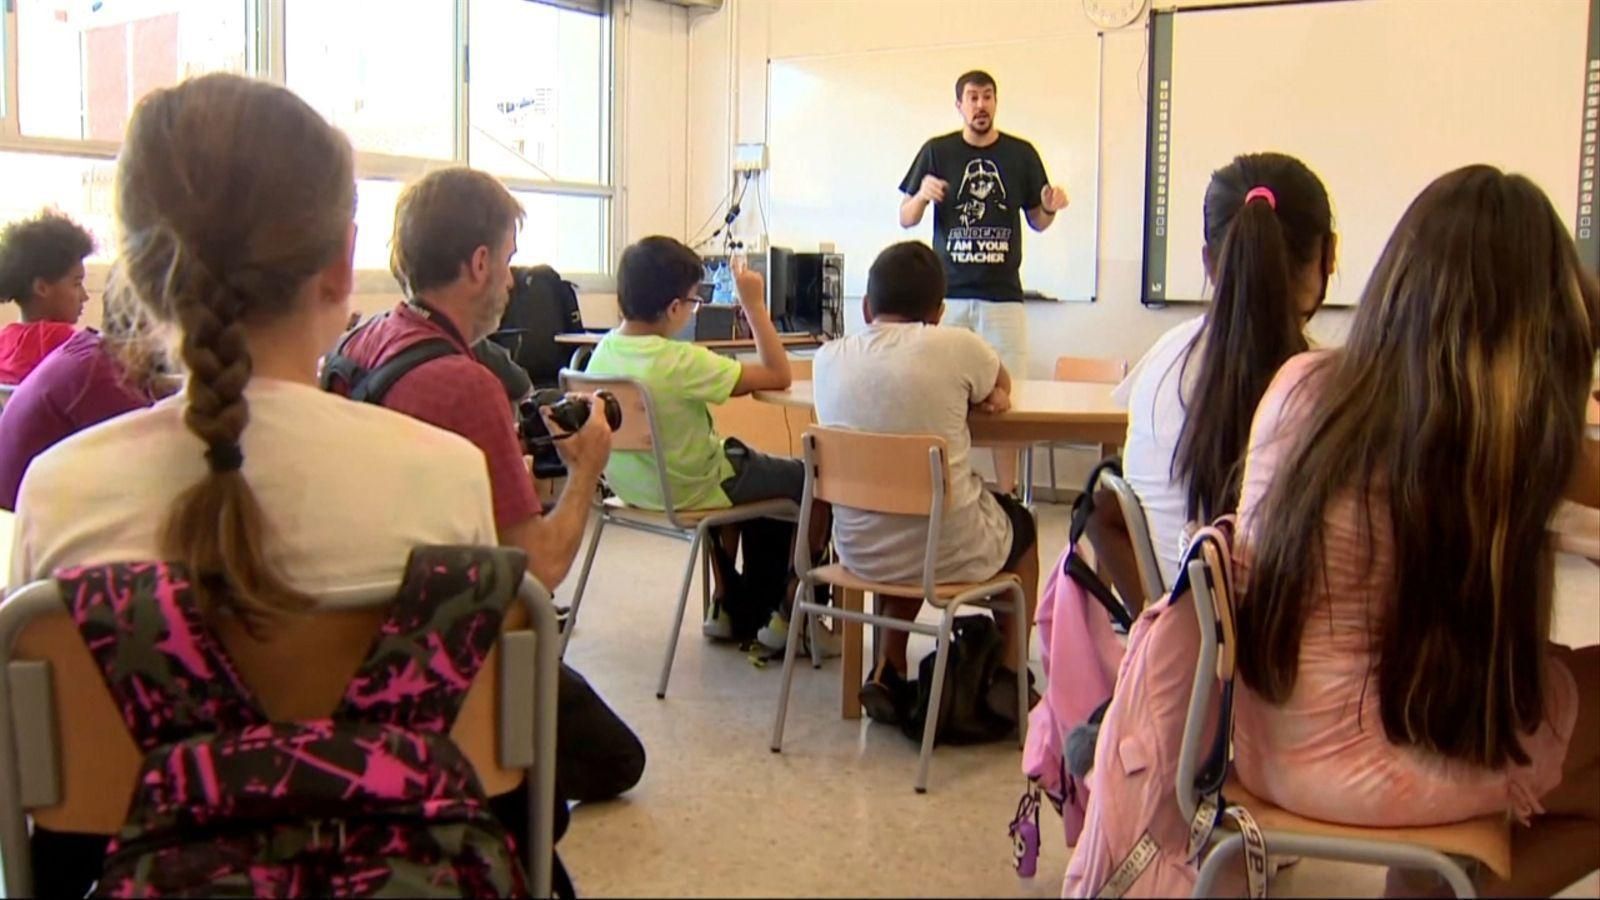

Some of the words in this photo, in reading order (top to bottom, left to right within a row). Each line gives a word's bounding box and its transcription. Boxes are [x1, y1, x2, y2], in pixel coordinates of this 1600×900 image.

[946, 240, 951, 252] I
[953, 240, 972, 251] AM
[976, 240, 1009, 251] YOUR
[951, 252, 1005, 262] TEACHER
